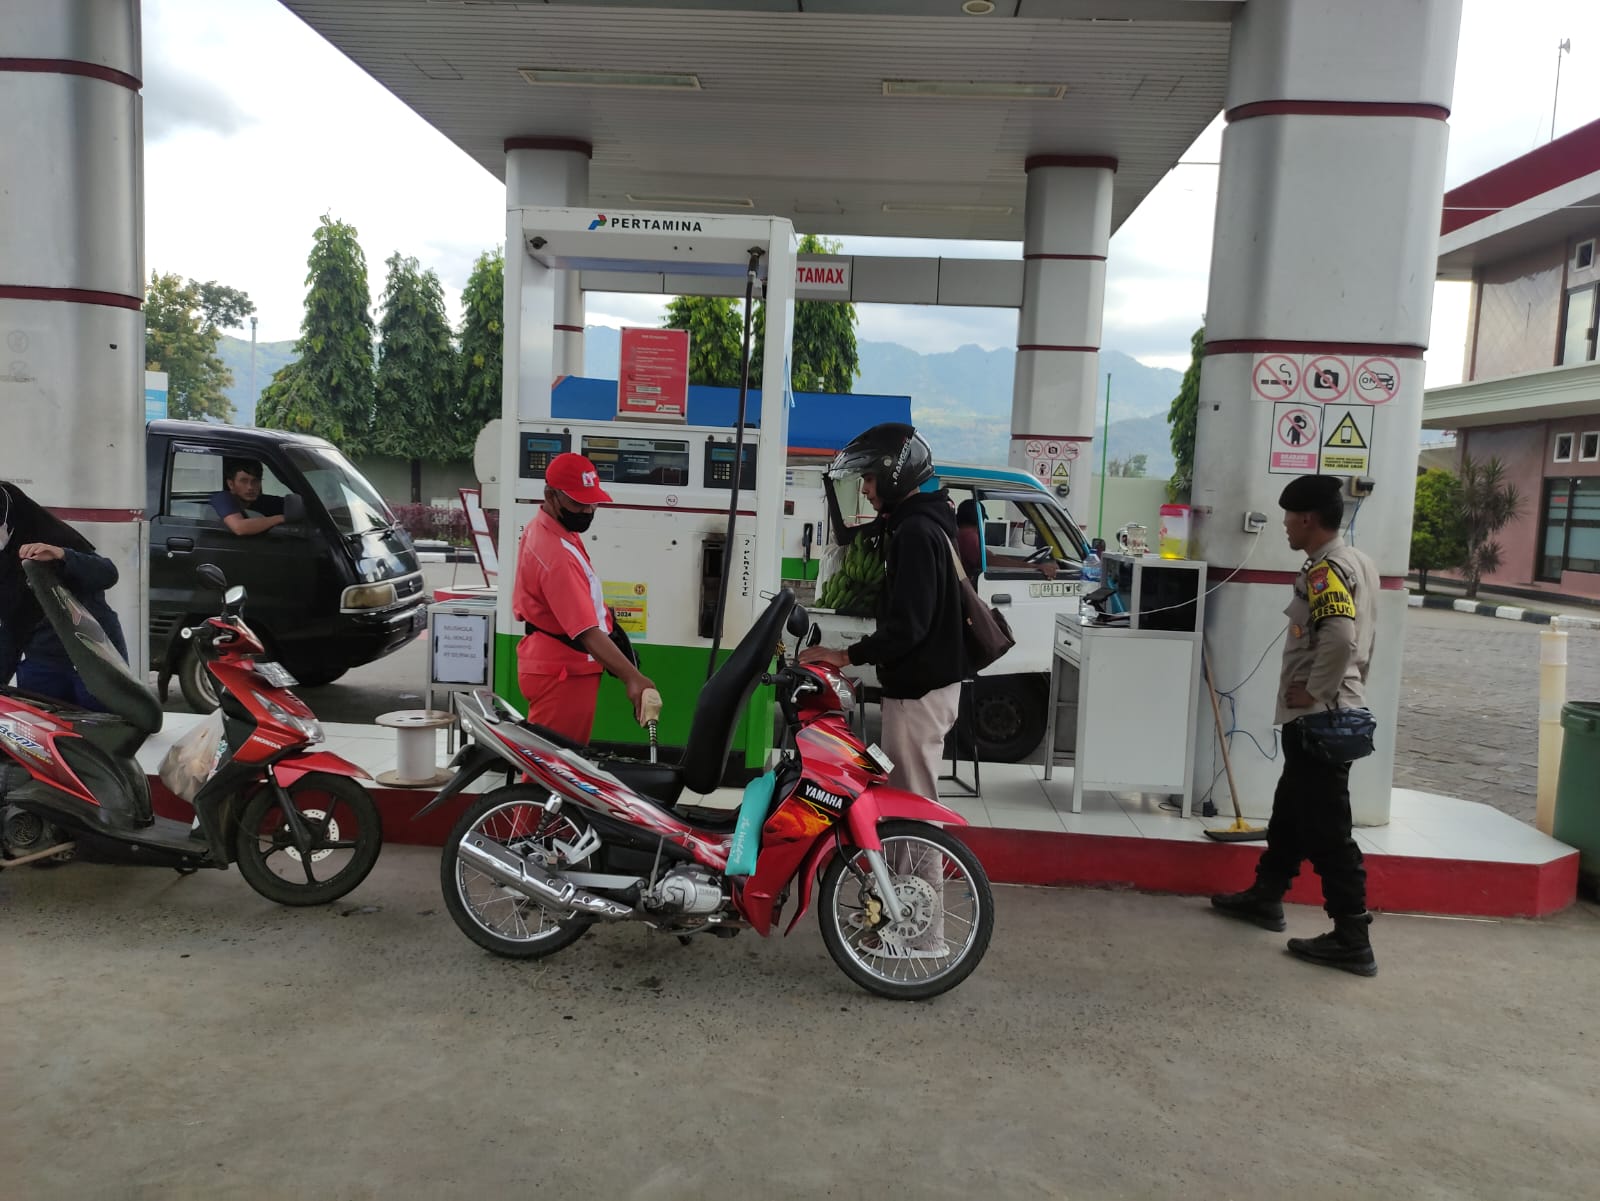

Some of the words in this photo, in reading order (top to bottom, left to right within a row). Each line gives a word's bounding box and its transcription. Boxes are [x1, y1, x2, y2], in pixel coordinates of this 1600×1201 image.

[611, 217, 702, 232] PERTAMINA
[795, 266, 844, 284] TAMAX
[252, 735, 282, 750] HONDA
[805, 784, 843, 809] YAMAHA
